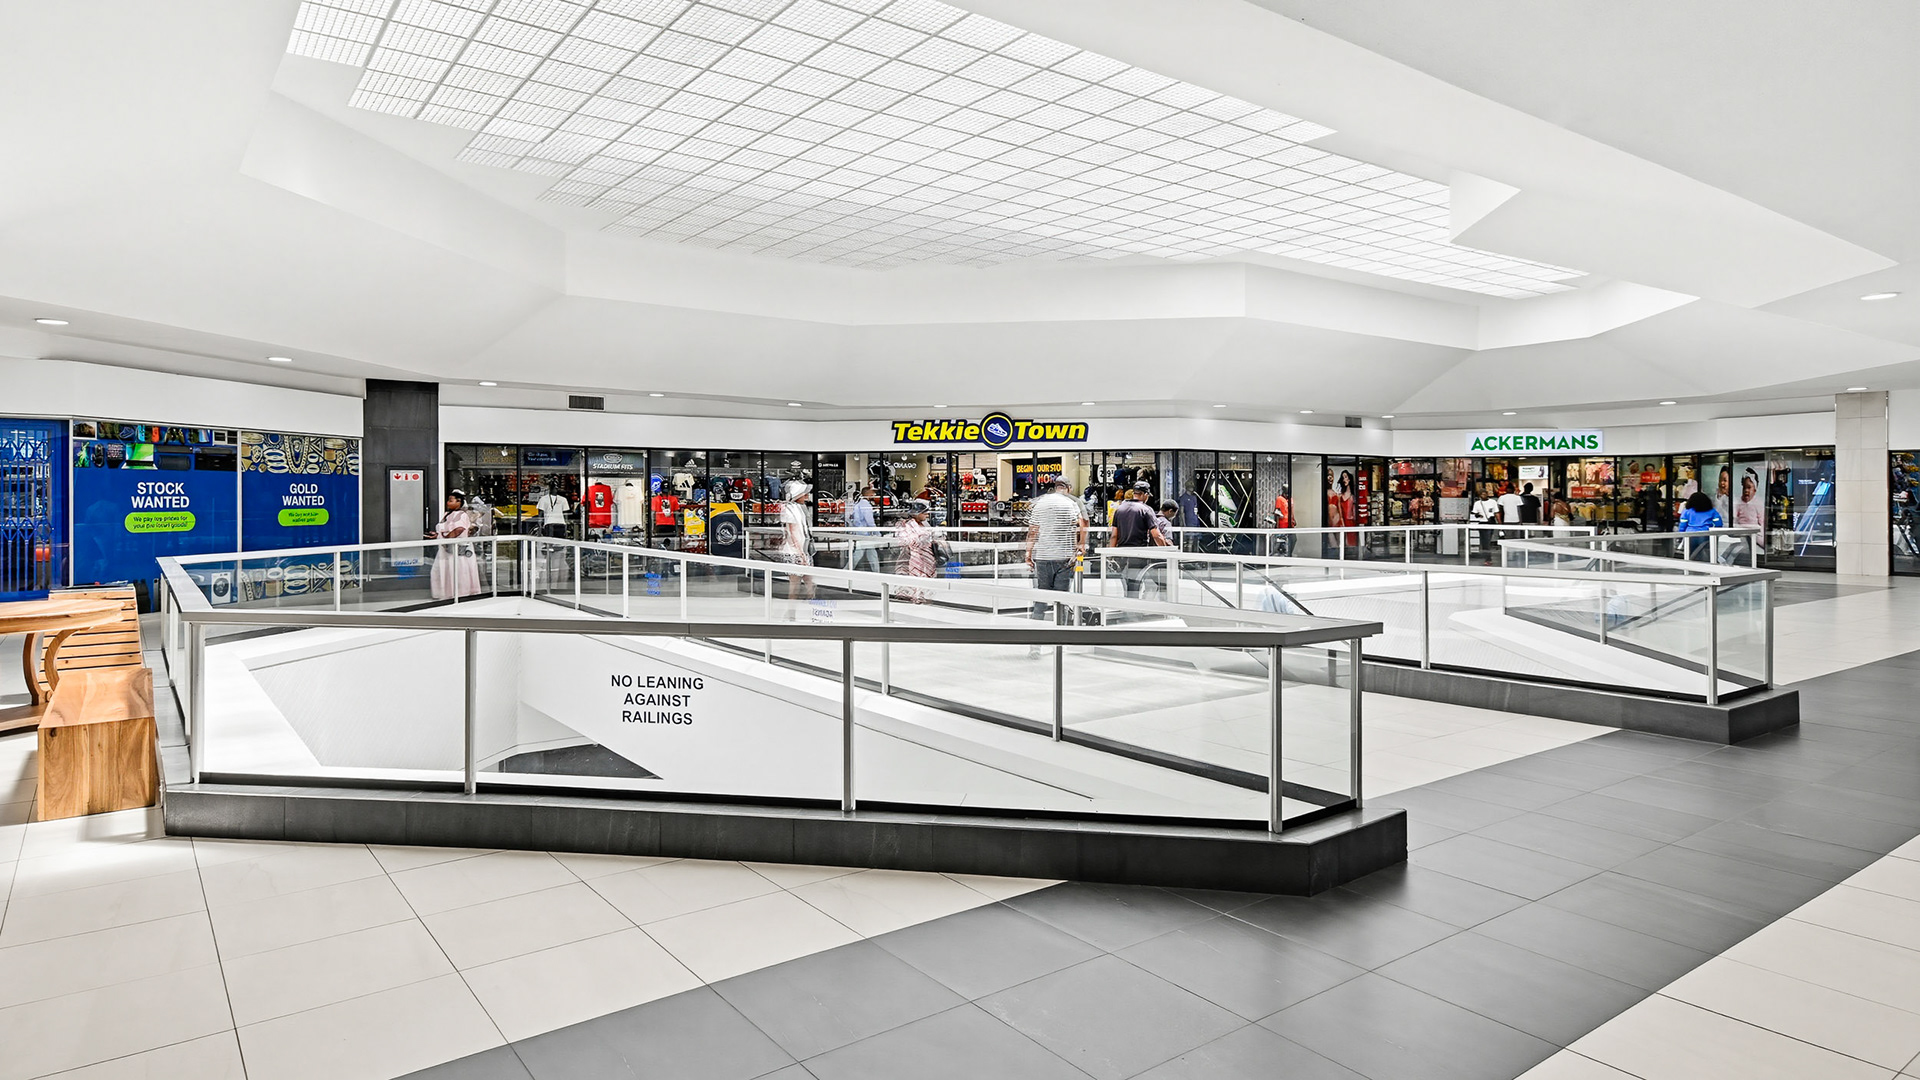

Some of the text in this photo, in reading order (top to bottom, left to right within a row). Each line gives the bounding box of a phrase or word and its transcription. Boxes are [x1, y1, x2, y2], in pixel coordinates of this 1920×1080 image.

[893, 421, 1086, 441] Tekkie Town
[1471, 434, 1599, 451] ACKERMANS
[1016, 464, 1034, 473] BEGIN
[1036, 463, 1049, 473] OUR
[137, 482, 185, 495] STOCK
[289, 483, 318, 494] GOLD
[131, 496, 190, 508] WANTED
[282, 495, 325, 506] WANTED
[611, 674, 704, 690] NO LEANING
[623, 692, 691, 707] AGAINST
[622, 710, 693, 725] RAILINGS
